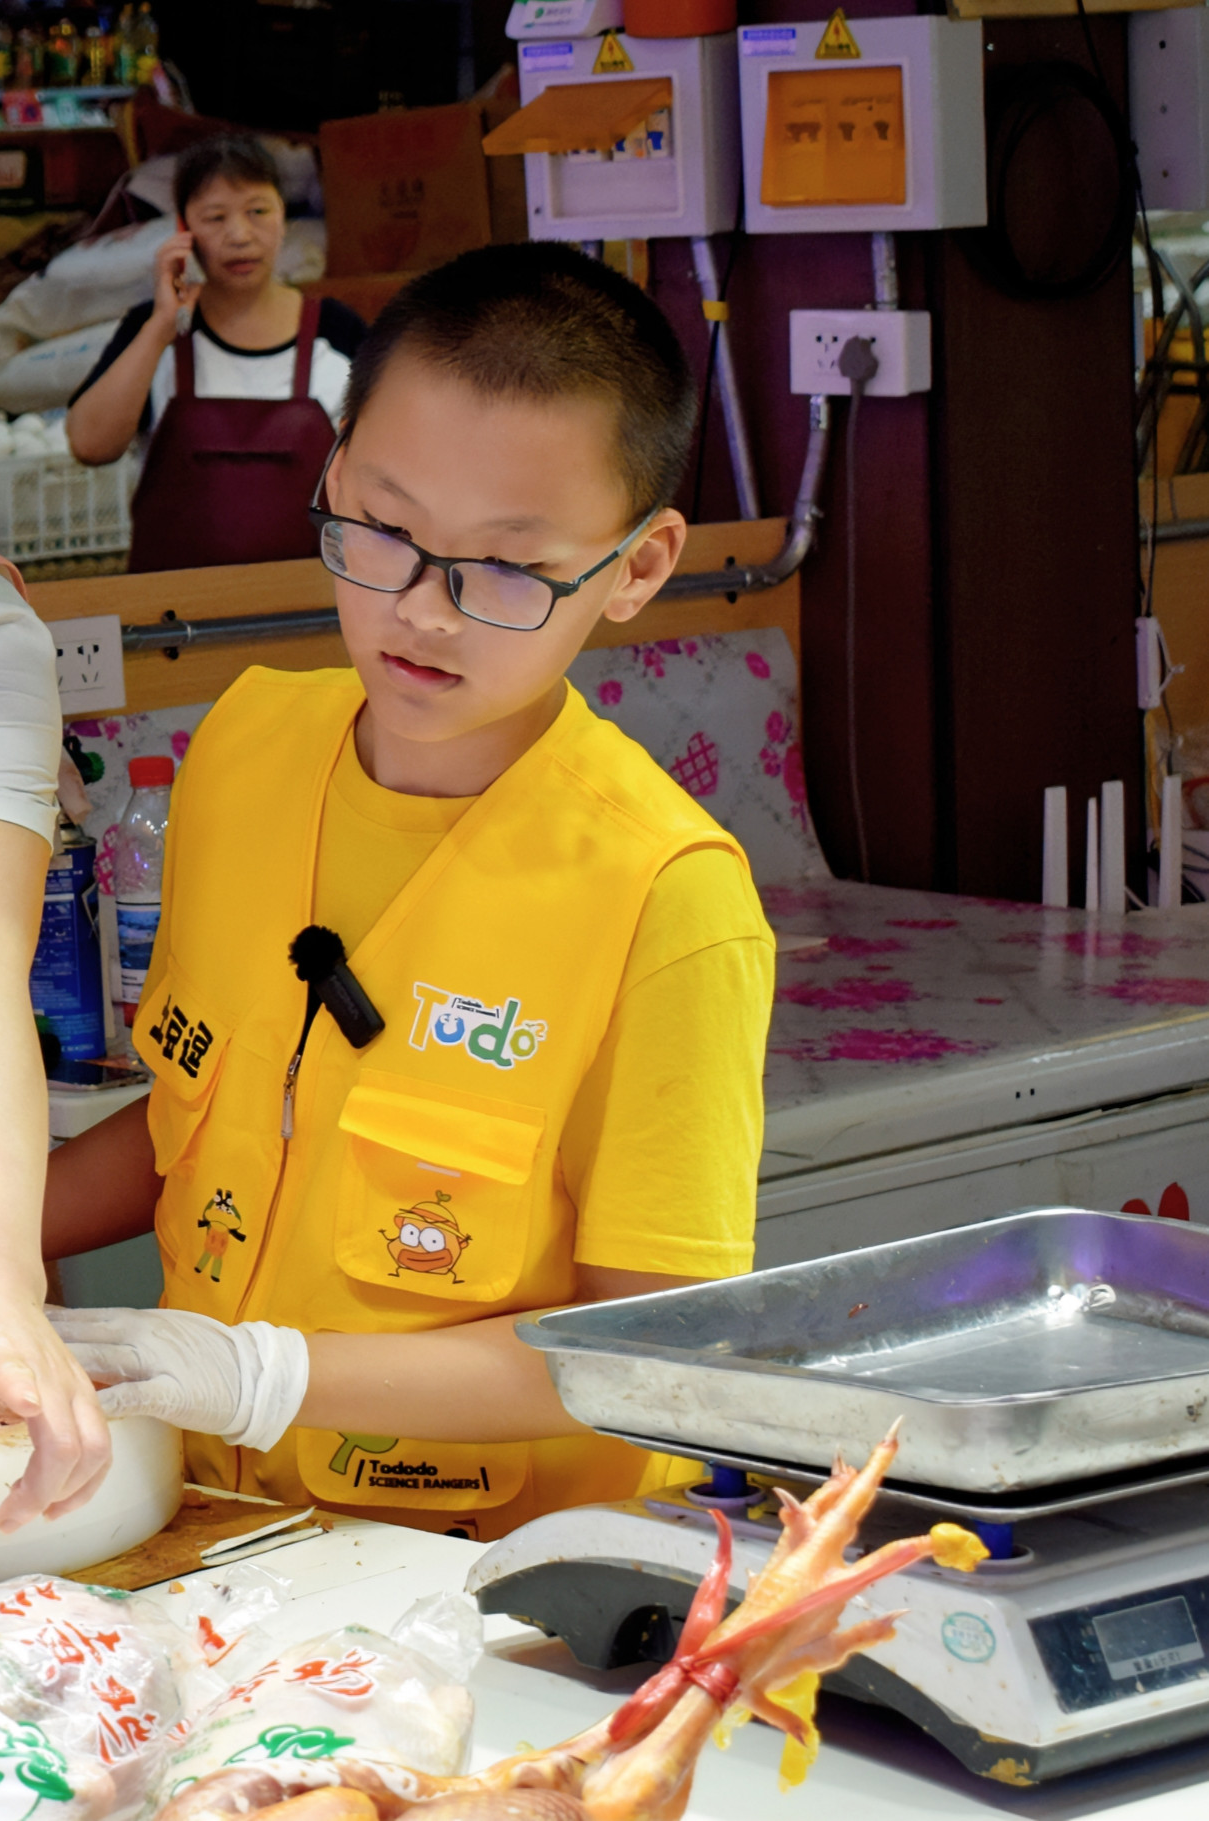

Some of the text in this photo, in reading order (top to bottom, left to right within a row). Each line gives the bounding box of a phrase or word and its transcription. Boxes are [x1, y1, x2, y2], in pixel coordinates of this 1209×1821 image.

[369, 1460, 438, 1476] Tododo
[368, 1476, 480, 1490] SCIENCE RANGERS
